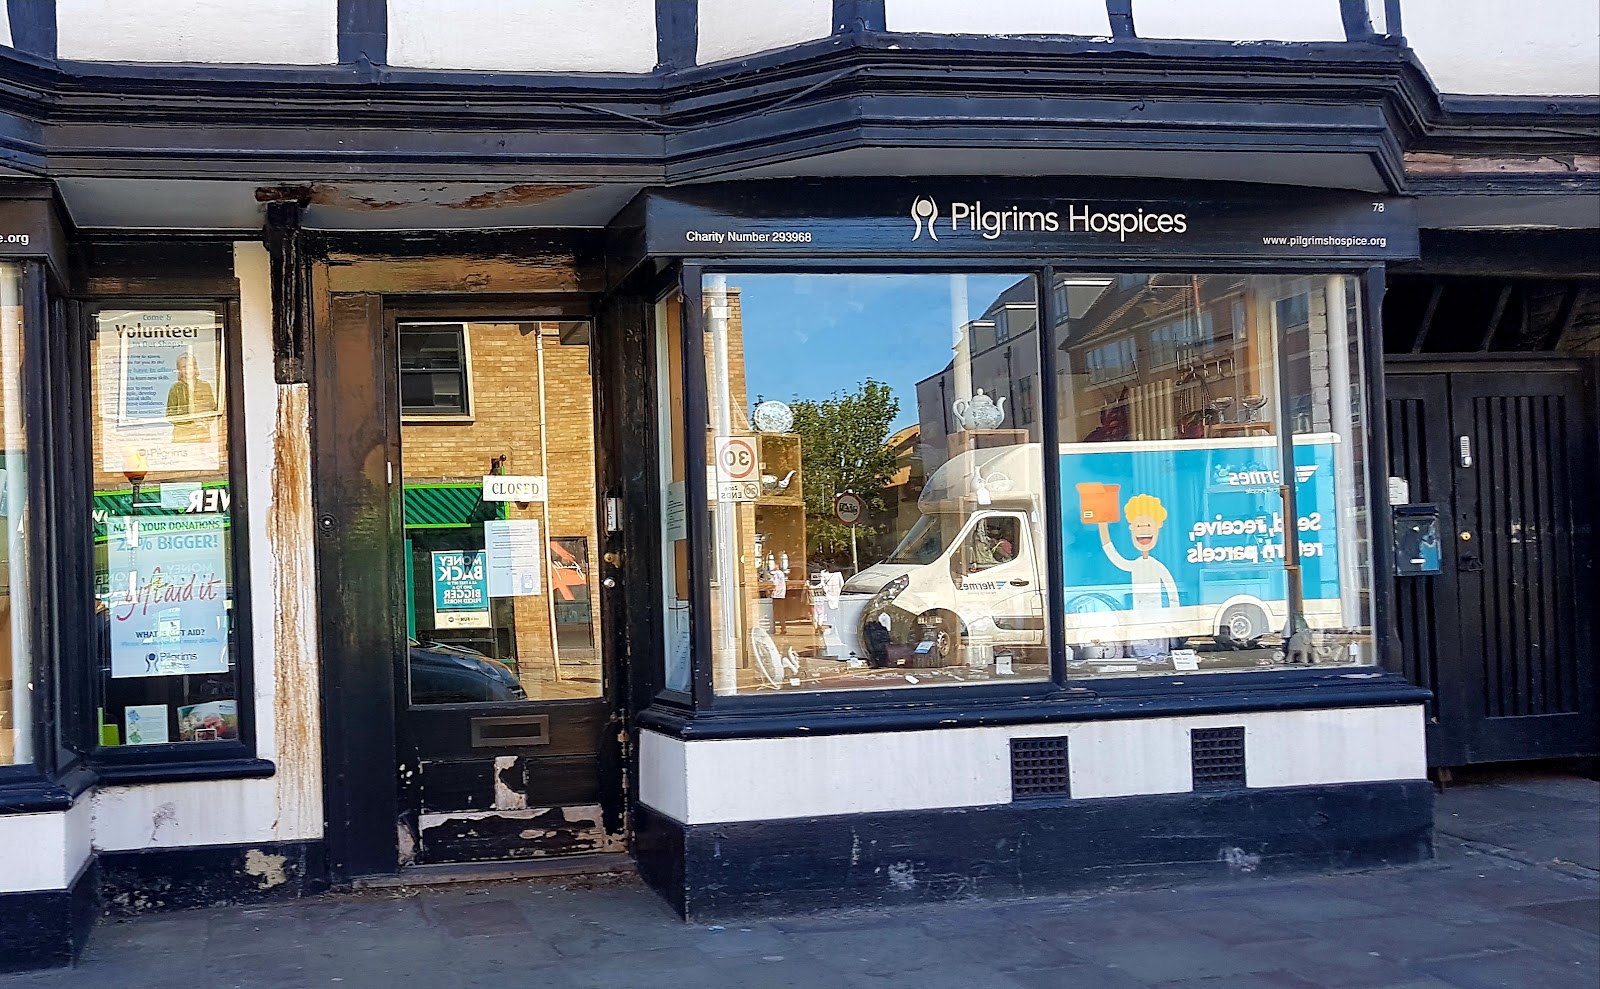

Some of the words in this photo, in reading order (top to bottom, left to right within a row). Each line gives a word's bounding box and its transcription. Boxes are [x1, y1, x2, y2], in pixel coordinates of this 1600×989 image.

[1371, 202, 1385, 213] 78
[951, 200, 1060, 240] Pilgrims
[1069, 204, 1188, 243] Hospices
[685, 230, 725, 244] Charity
[727, 231, 770, 243] Number
[772, 230, 813, 243] 293968
[1262, 235, 1387, 248] www.pilgrimshospice.org
[115, 322, 199, 339] Volunteer
[491, 482, 540, 495] CLOSED
[142, 522, 166, 532] YOUR
[168, 520, 220, 532] DONATIONS
[157, 534, 219, 550] BIGGER!
[135, 630, 158, 639] WHAT
[187, 628, 206, 636] AID?
[160, 652, 198, 662] Pilgrims
